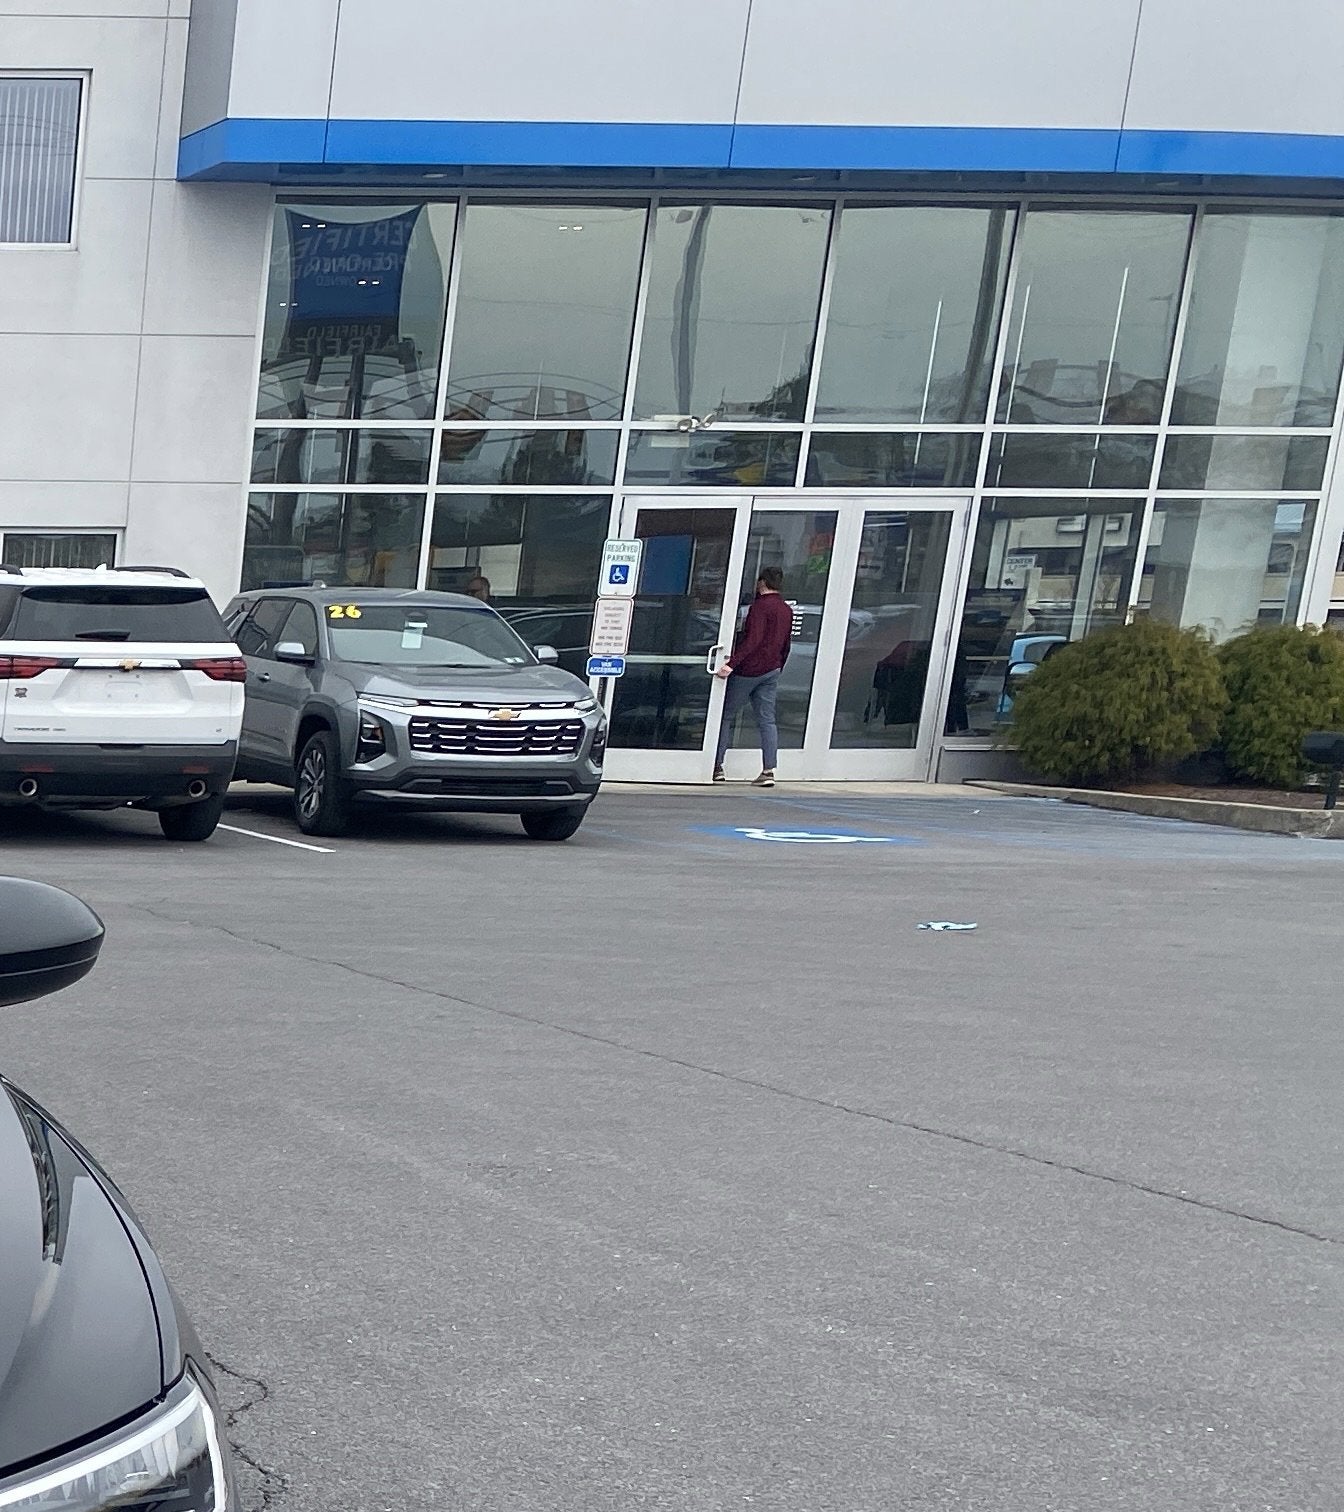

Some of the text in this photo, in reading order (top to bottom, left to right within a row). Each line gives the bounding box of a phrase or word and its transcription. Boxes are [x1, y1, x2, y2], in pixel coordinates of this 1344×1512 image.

[606, 544, 638, 553] RESERVED
[607, 554, 636, 562] PARKING
[328, 605, 362, 619] 26
